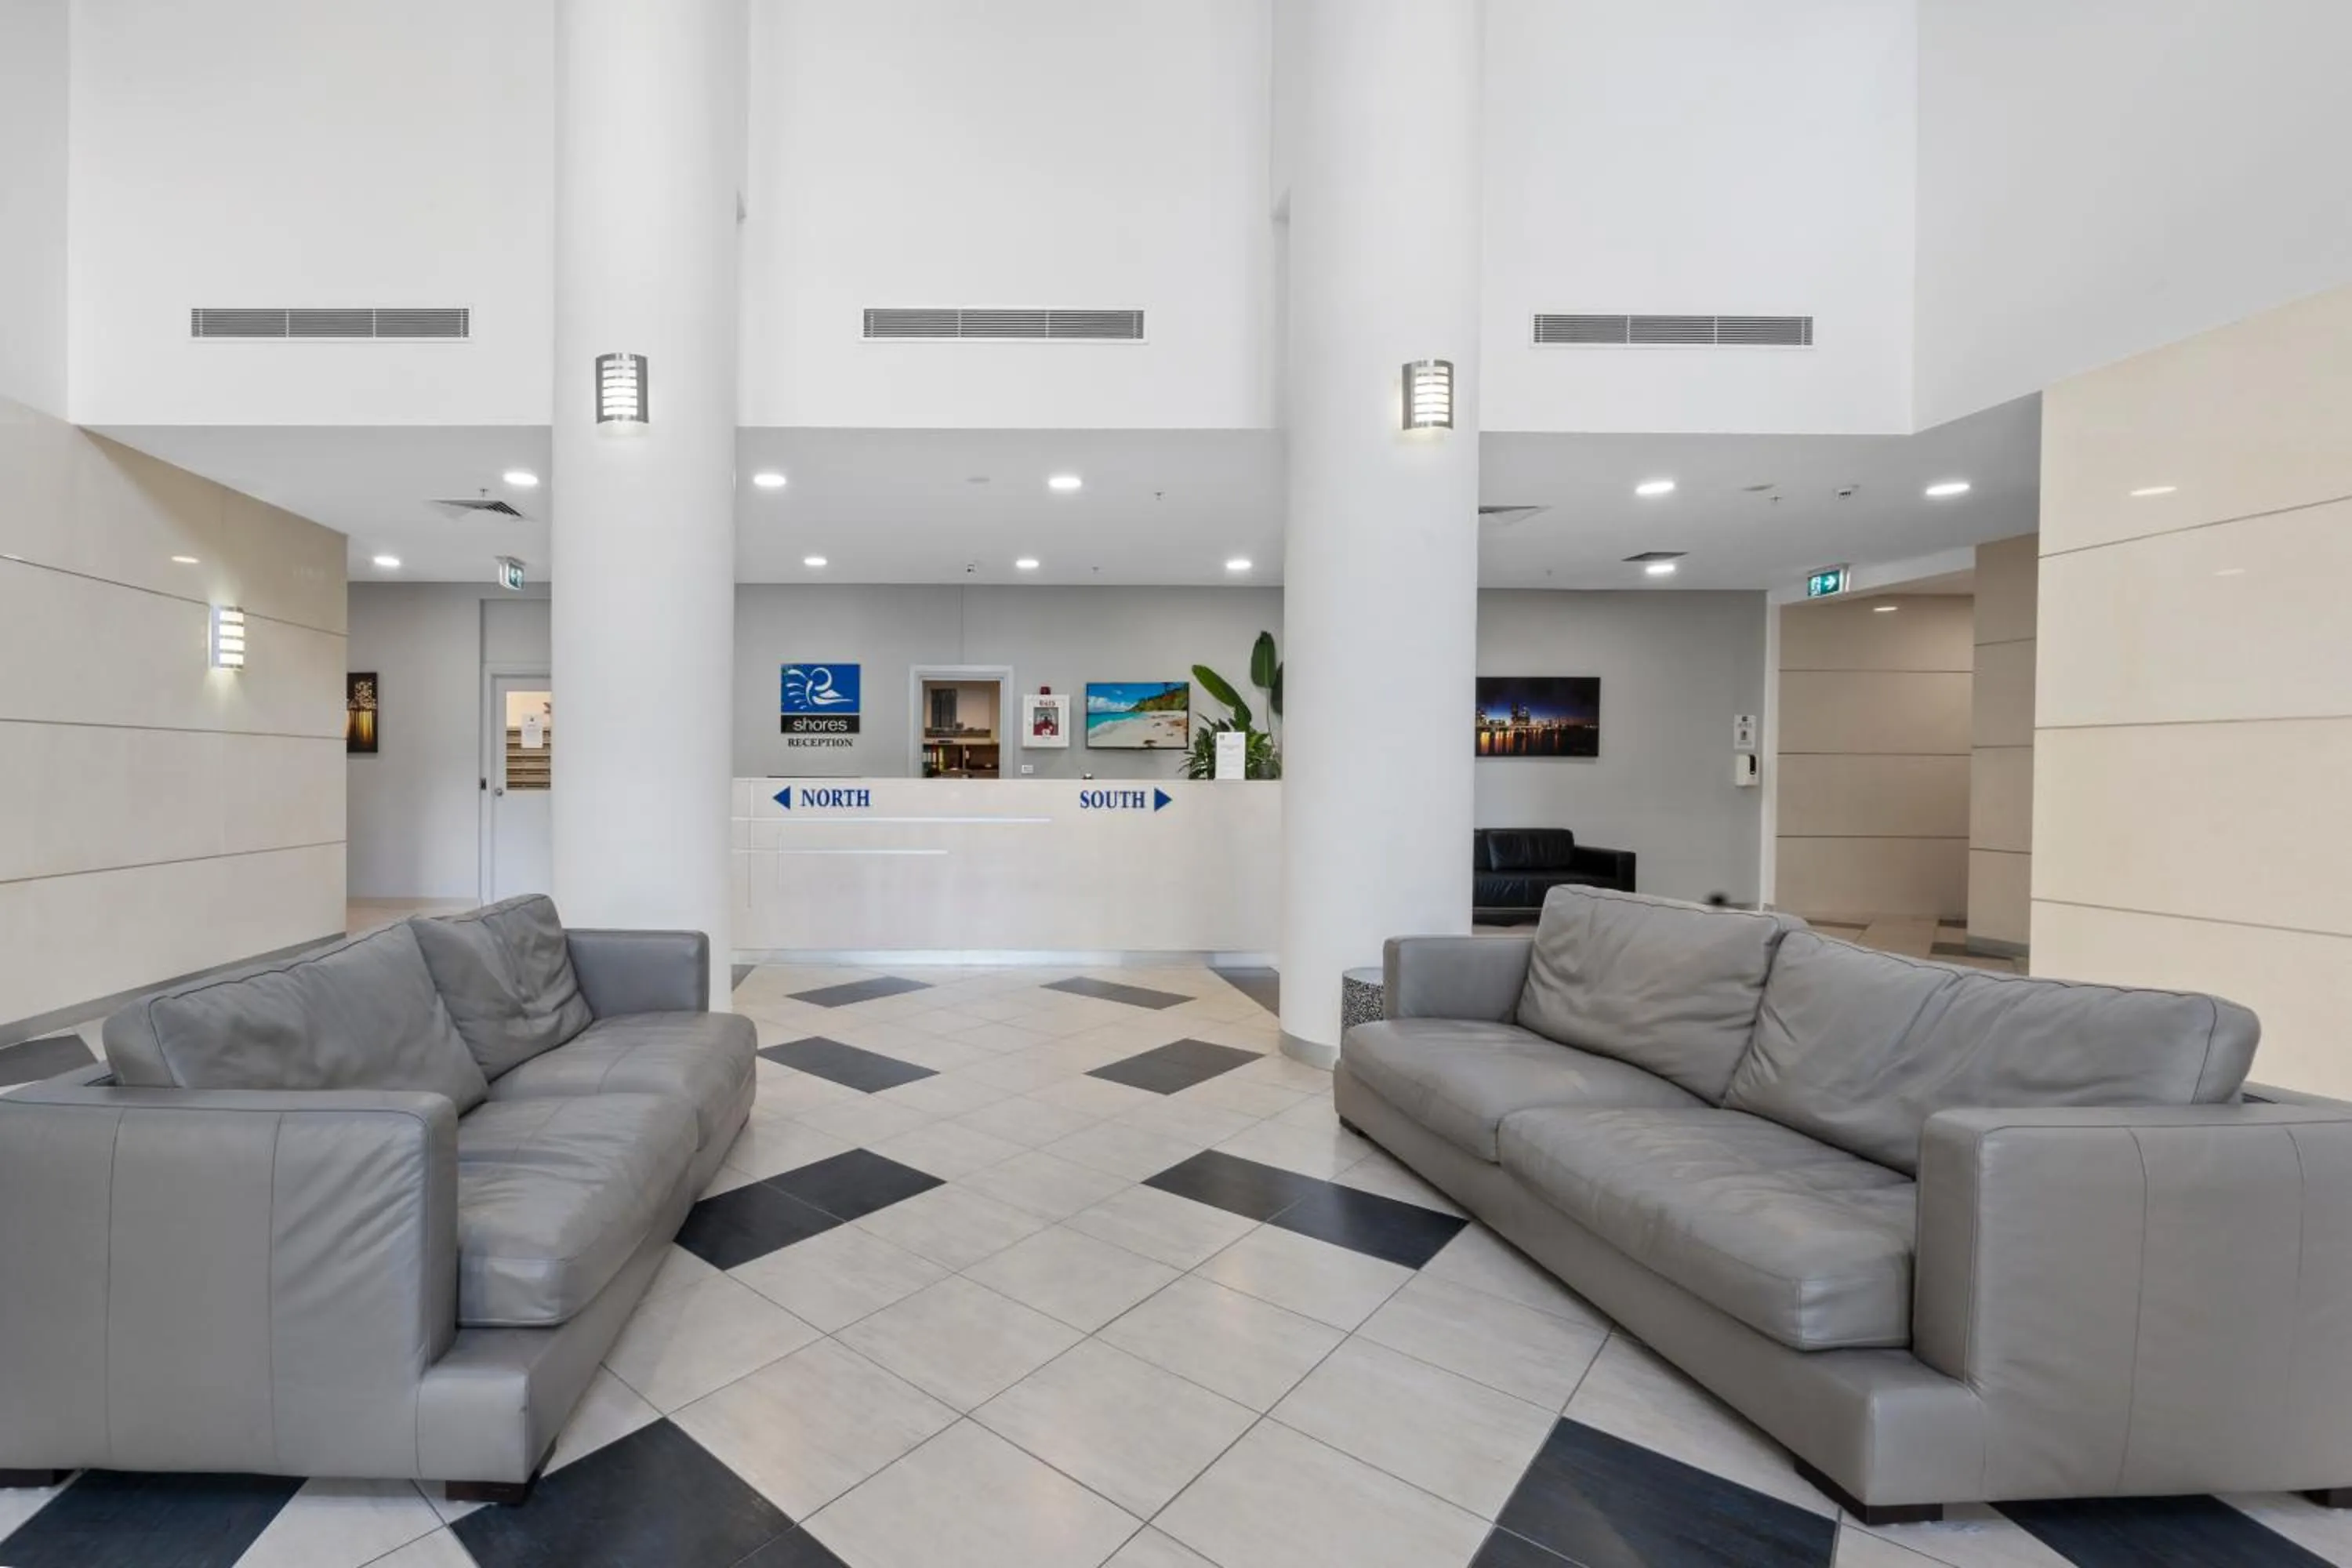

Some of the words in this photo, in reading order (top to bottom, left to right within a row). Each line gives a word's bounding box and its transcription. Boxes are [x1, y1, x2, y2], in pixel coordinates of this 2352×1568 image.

[793, 717, 848, 731] shores
[787, 738, 854, 747] RECEPTION
[800, 788, 870, 807] NORTH
[1080, 789, 1145, 808] SOUTH
